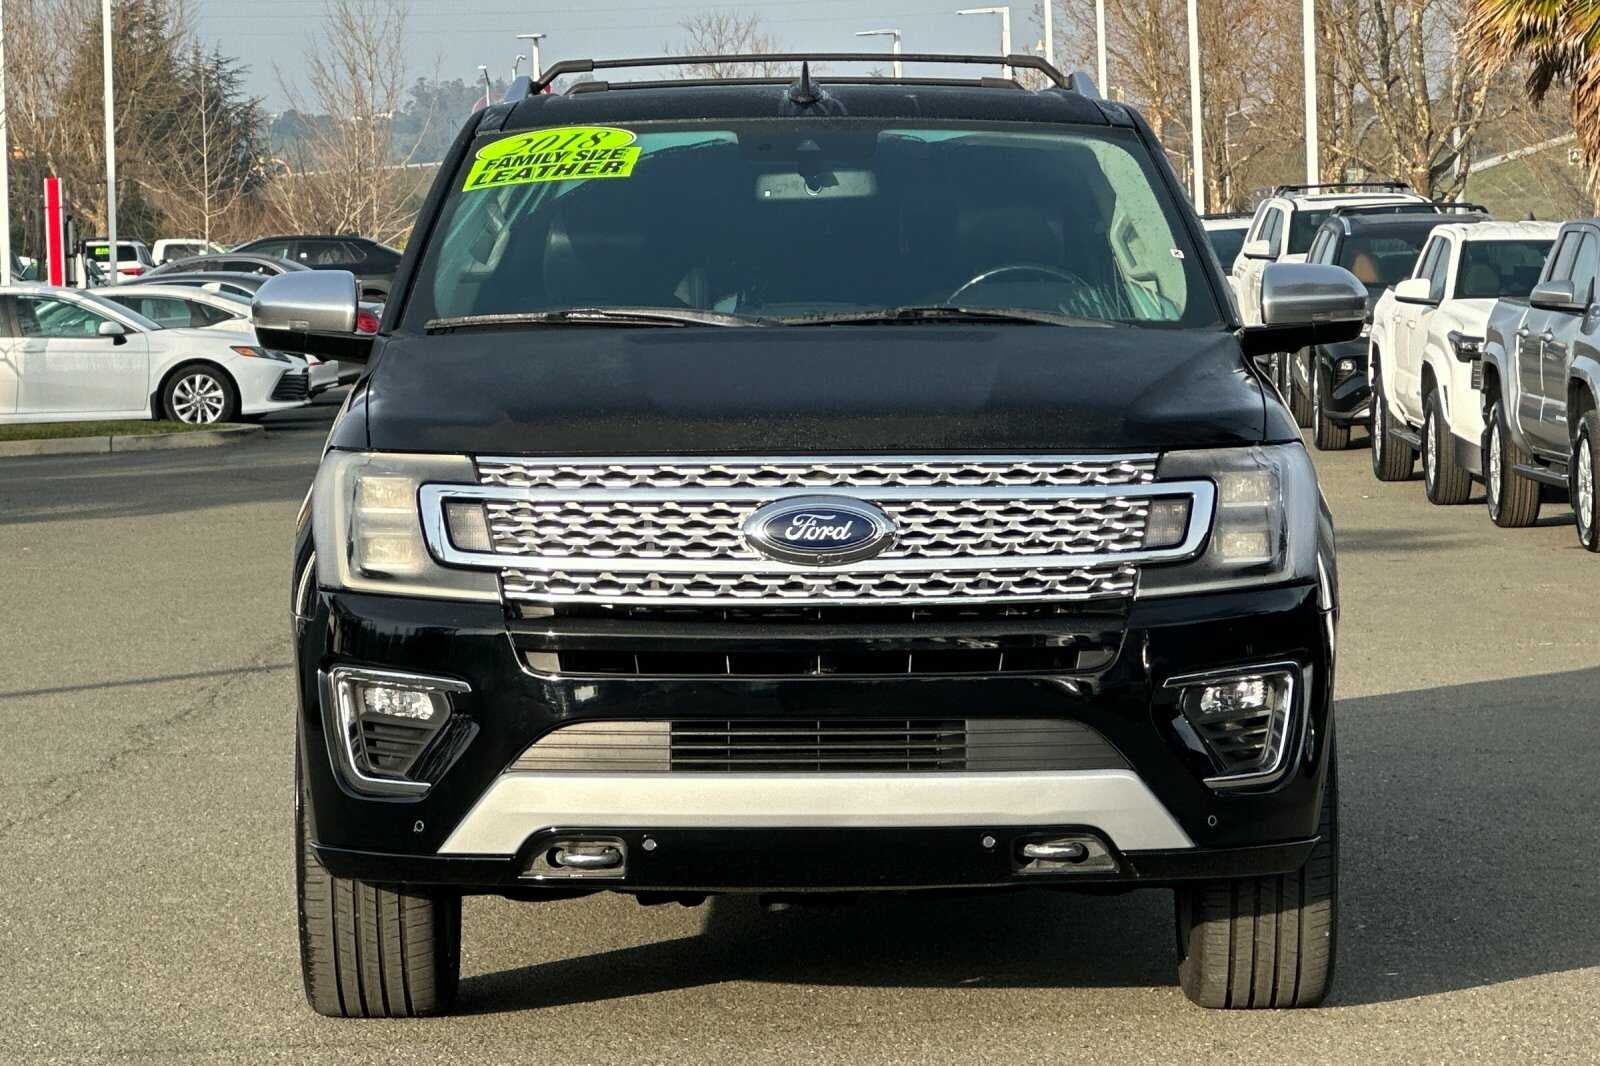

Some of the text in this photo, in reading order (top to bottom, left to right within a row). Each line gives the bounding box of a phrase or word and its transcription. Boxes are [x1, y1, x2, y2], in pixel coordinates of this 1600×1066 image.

[500, 131, 611, 156] 2018
[482, 148, 626, 171] FAMILY SIZE
[471, 160, 626, 186] LEATHER
[785, 513, 853, 541] Ford
